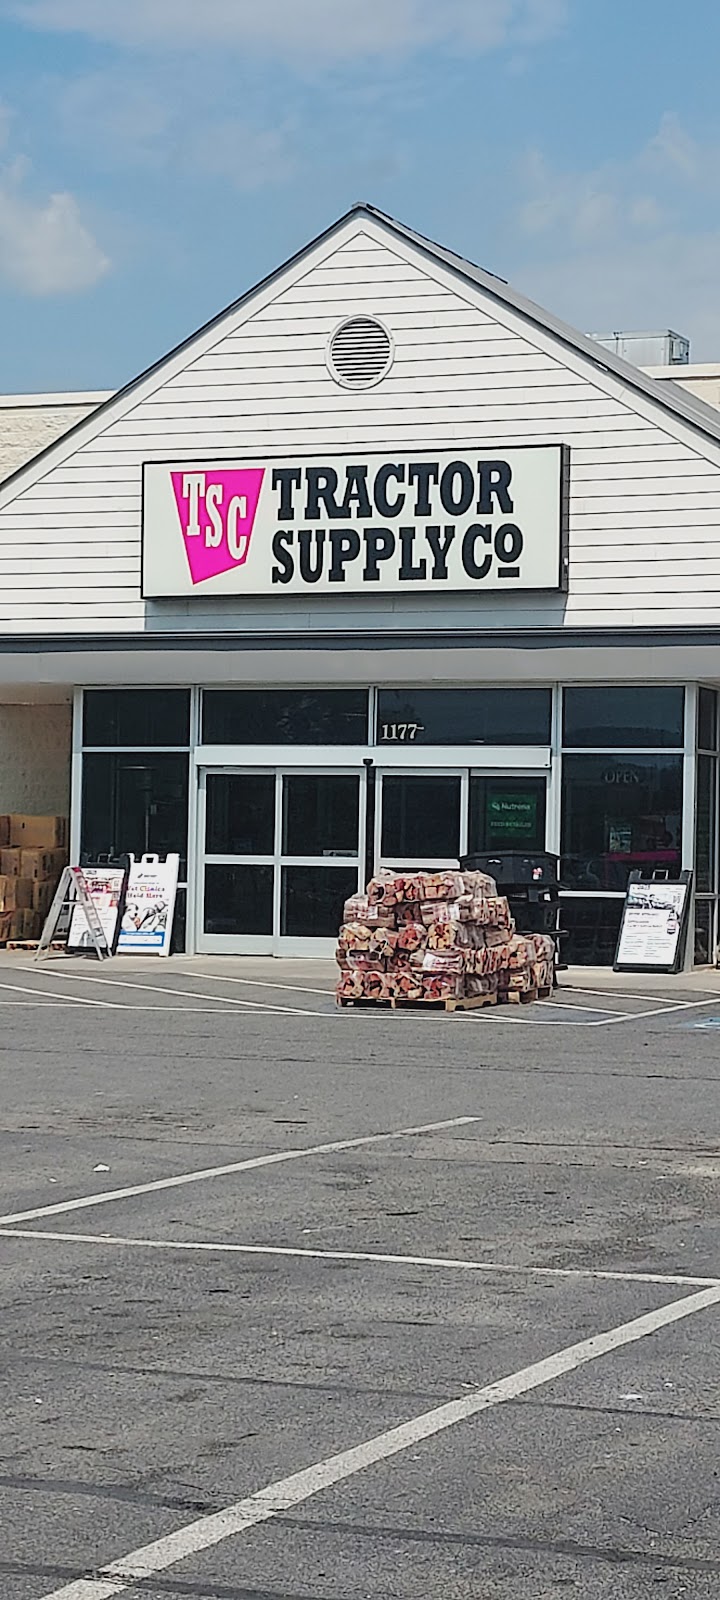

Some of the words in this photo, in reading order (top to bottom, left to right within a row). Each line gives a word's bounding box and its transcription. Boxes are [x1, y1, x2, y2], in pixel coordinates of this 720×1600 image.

[182, 474, 247, 561] TSC
[271, 460, 514, 520] TRACTOR
[271, 525, 456, 584] SUPPLY
[501, 801, 531, 811] Nutrena
[604, 769, 639, 784] OPEN
